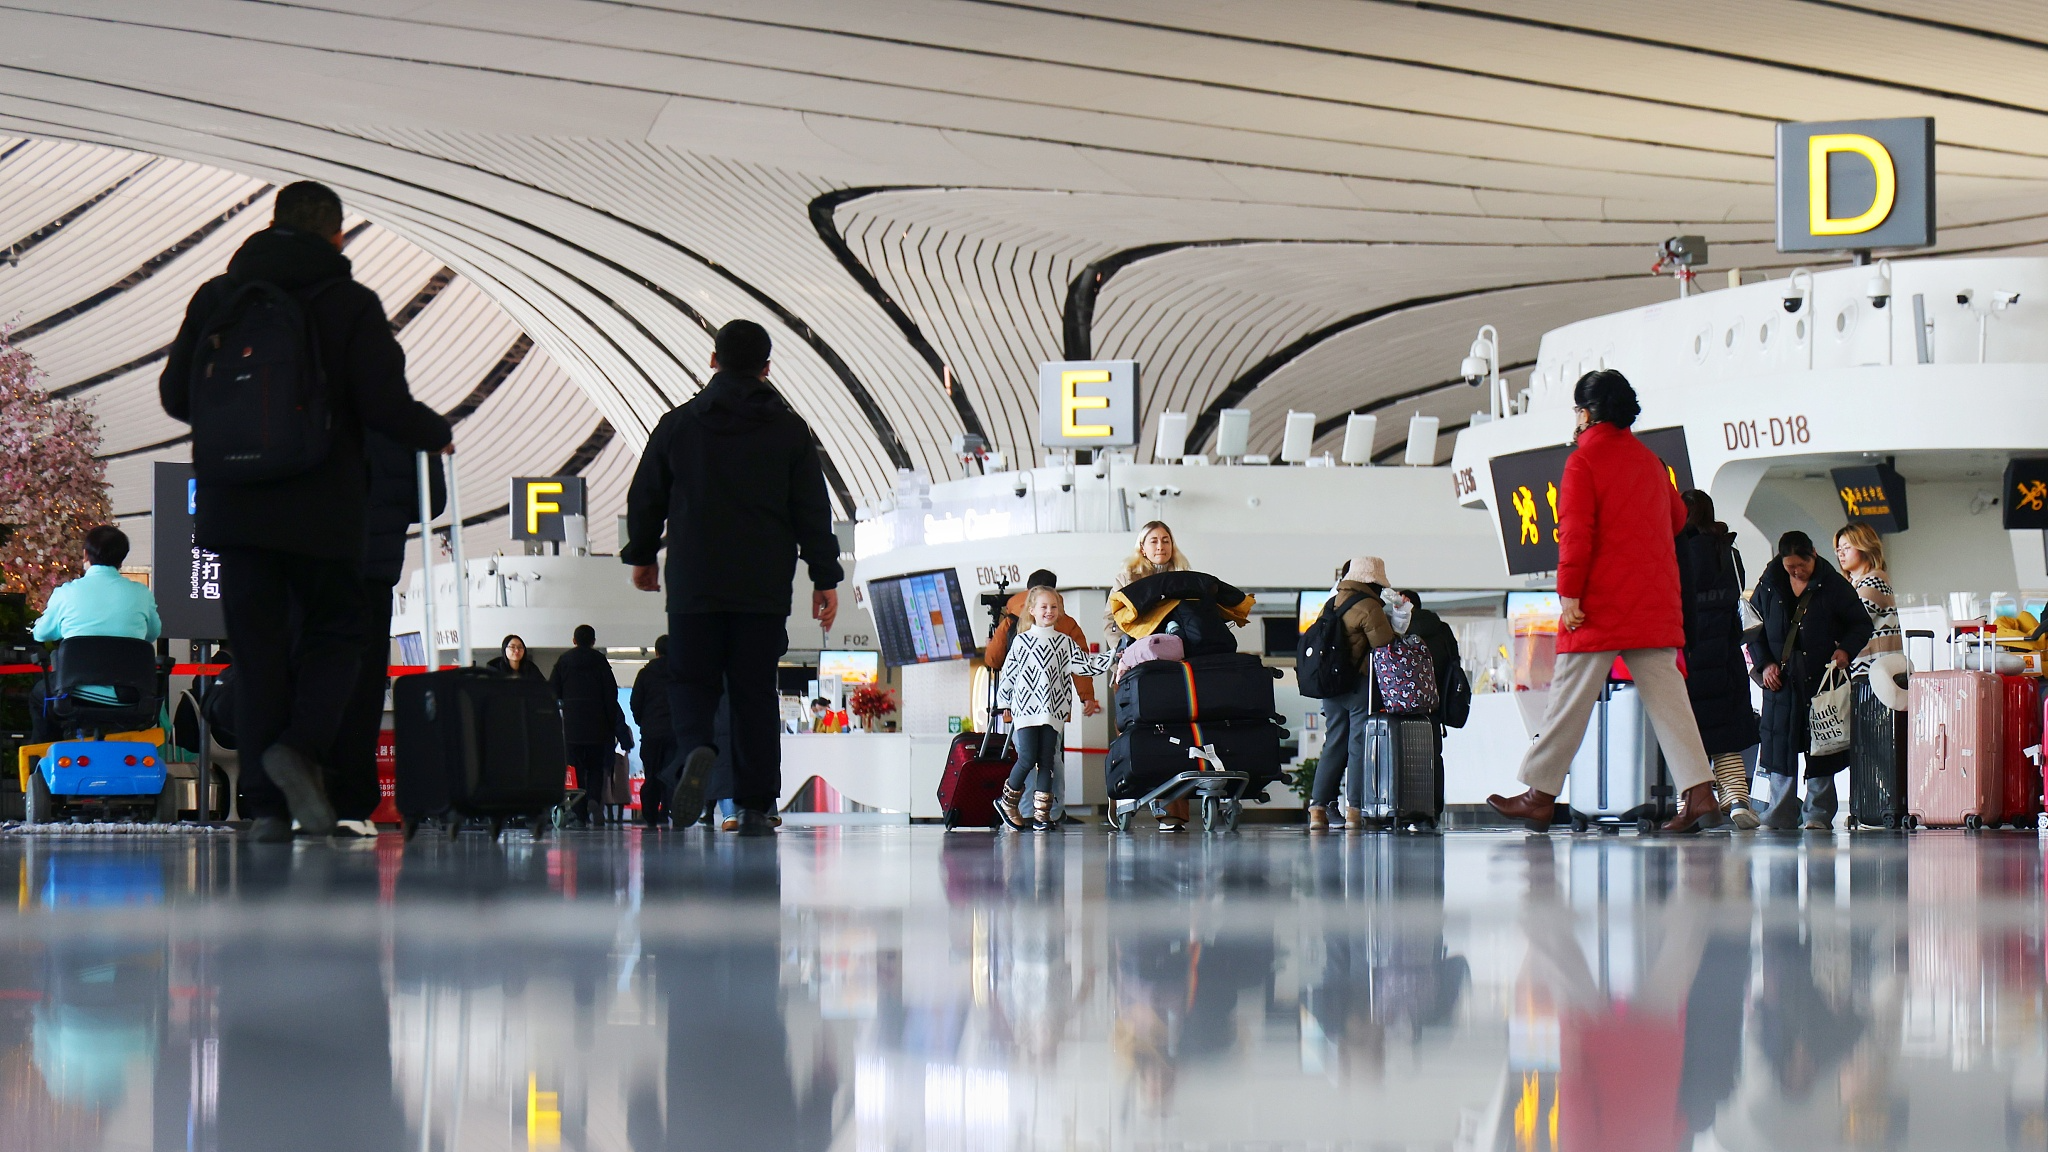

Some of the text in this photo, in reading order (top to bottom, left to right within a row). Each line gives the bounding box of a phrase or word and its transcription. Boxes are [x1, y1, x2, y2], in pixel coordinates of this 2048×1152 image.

[1809, 134, 1896, 236] D
[1062, 369, 1113, 437] E
[1723, 415, 1810, 450] D01-D18
[527, 482, 563, 534] F
[190, 560, 200, 599] Wrapping
[843, 634, 869, 646] F02
[1813, 727, 1843, 741] Paris
